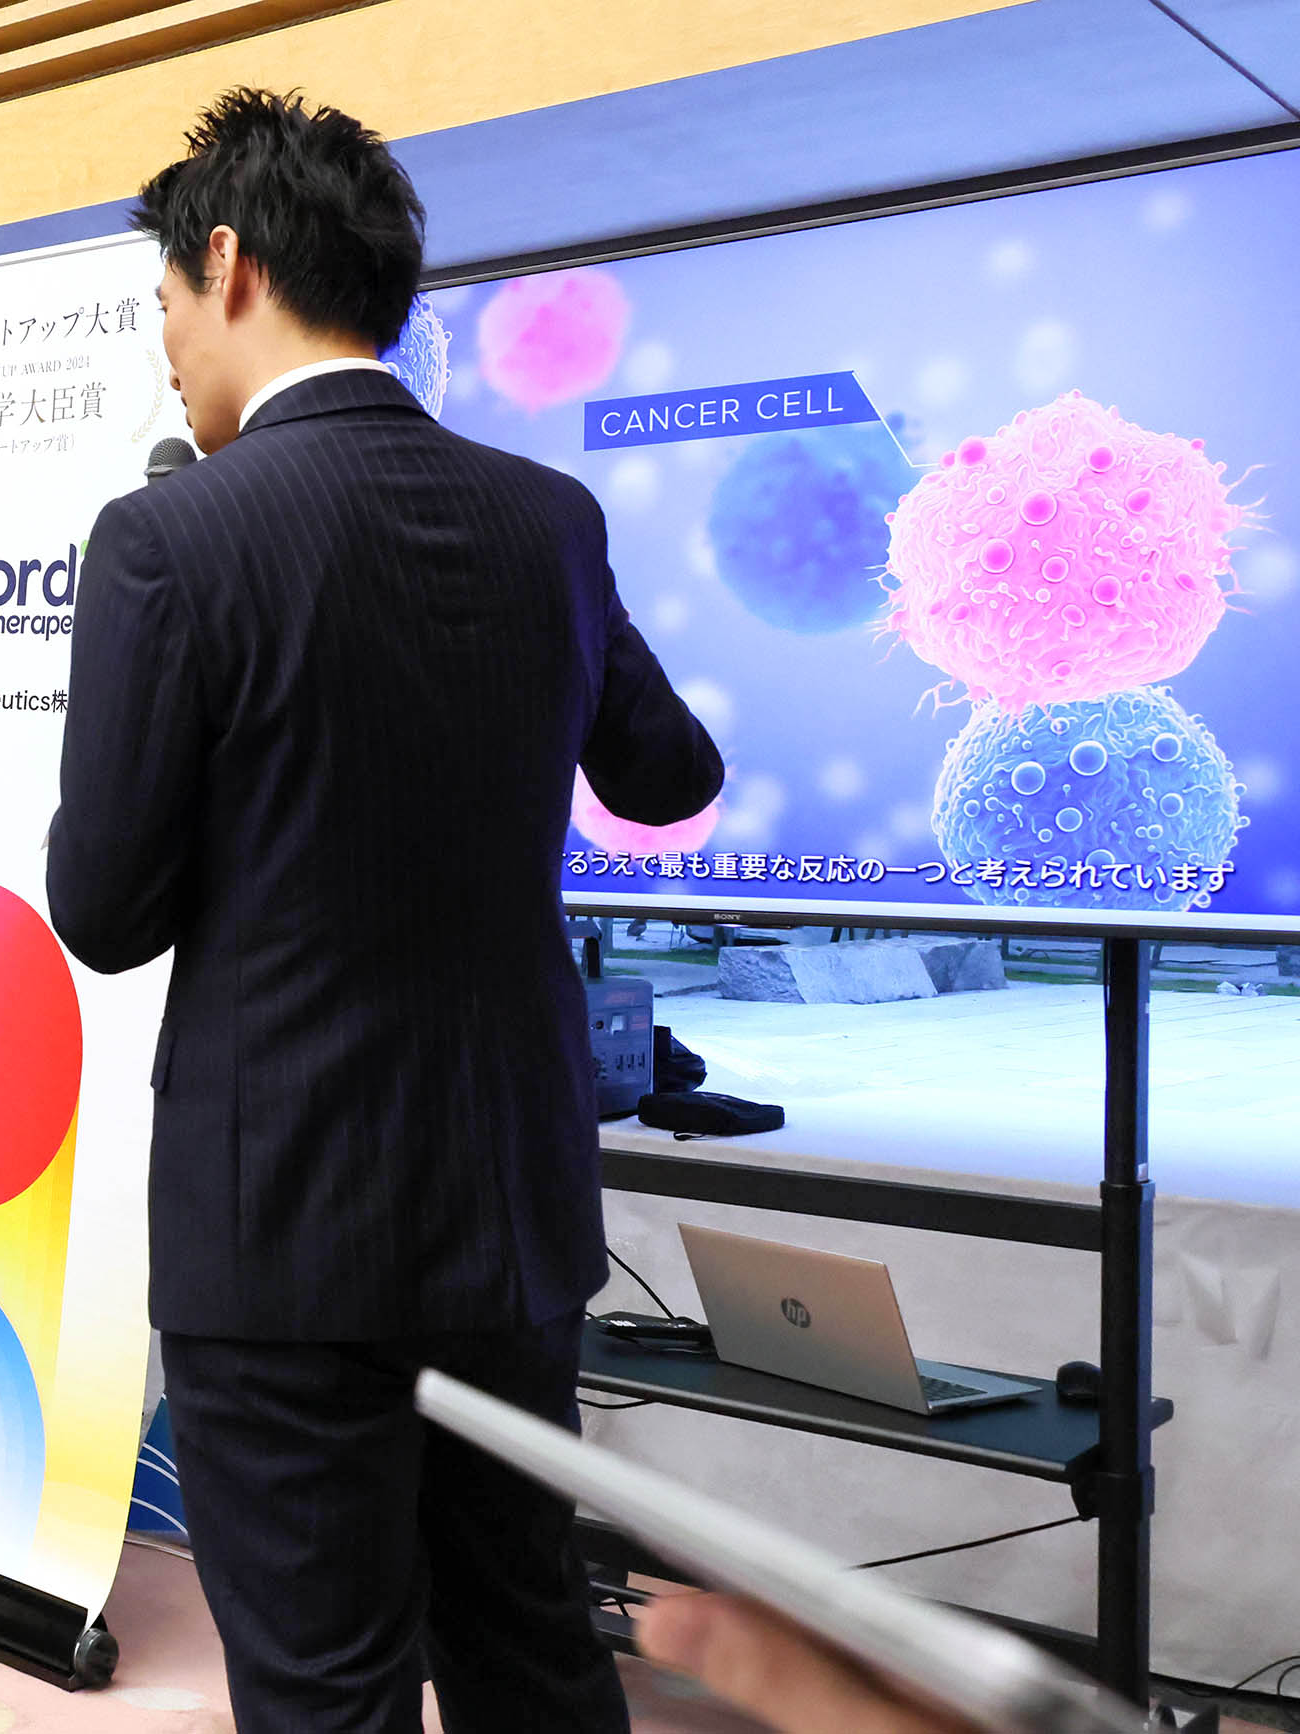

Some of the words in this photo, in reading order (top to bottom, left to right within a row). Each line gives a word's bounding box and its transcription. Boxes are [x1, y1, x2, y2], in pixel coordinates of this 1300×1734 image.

[21, 359, 61, 376] AWARD
[600, 398, 739, 436] CANCER
[756, 387, 843, 420] CELL
[562, 850, 1235, 893] るうえで最も重要な反応の一つと考えられています
[713, 913, 741, 921] SONY
